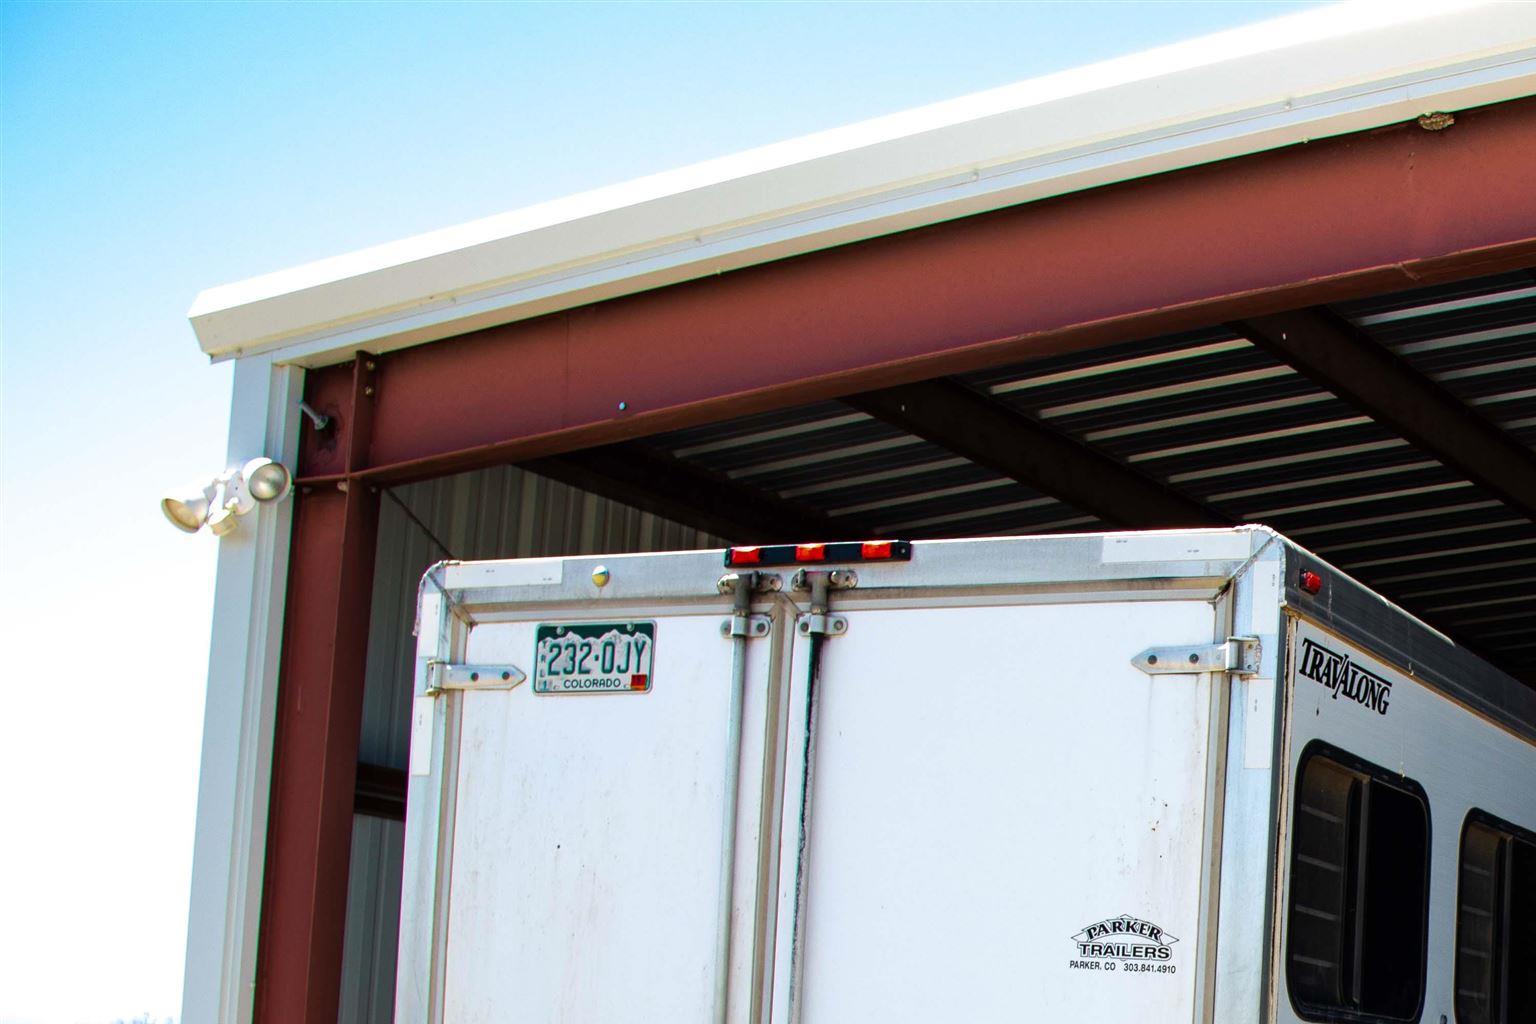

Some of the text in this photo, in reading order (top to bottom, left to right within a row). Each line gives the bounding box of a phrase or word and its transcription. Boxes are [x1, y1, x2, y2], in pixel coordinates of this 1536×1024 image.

[563, 678, 621, 689] COLORADO
[1299, 637, 1392, 715] TRAVALONG
[1086, 920, 1162, 941] PARKER
[1079, 943, 1170, 959] TRAILERS
[1104, 962, 1116, 971] CO
[1123, 962, 1176, 974] 303.841.4910
